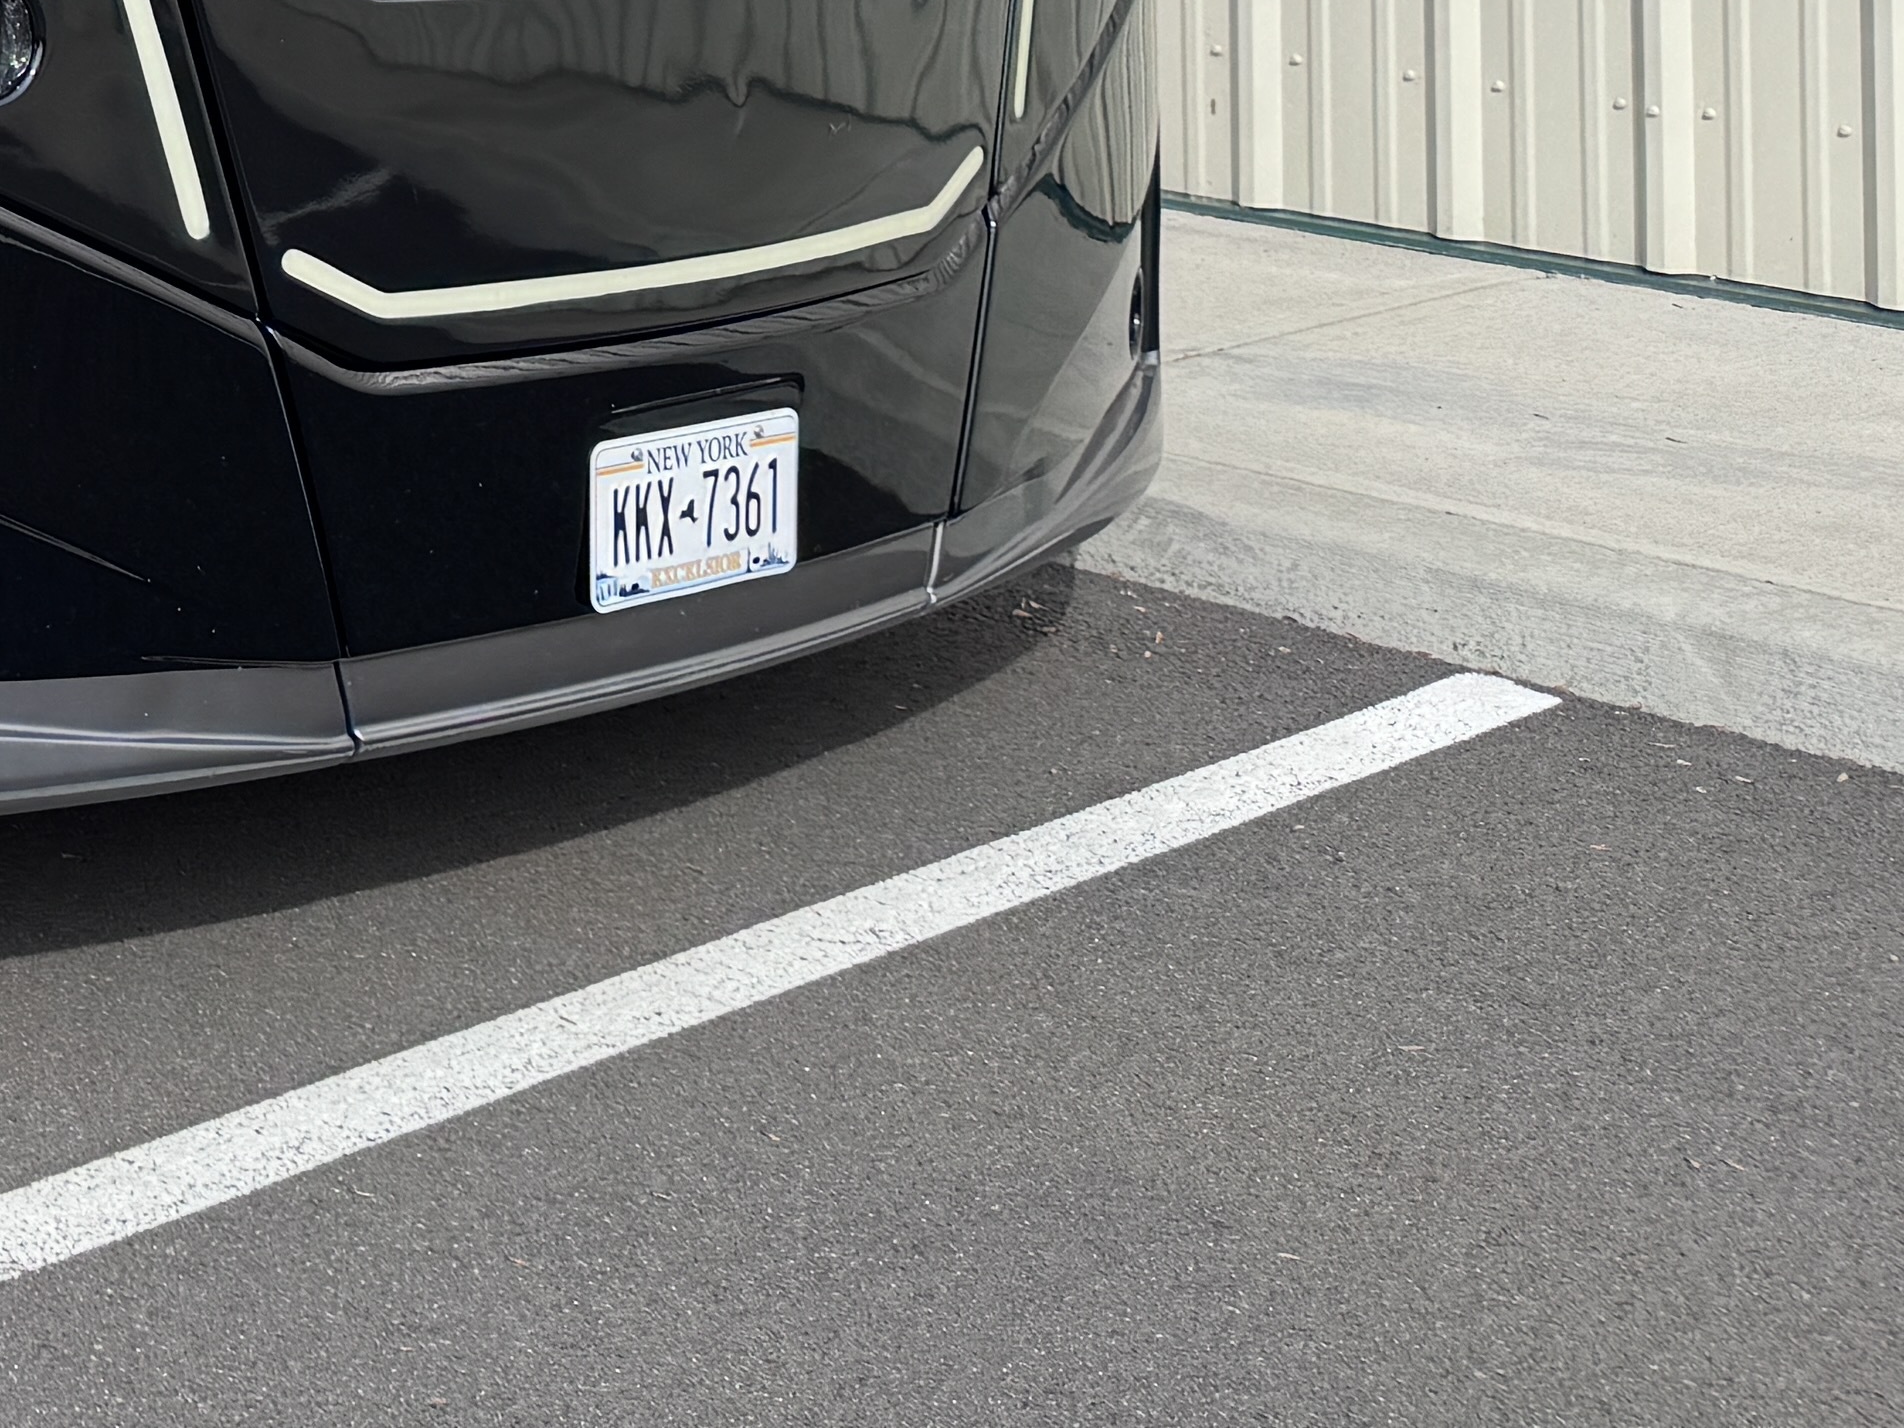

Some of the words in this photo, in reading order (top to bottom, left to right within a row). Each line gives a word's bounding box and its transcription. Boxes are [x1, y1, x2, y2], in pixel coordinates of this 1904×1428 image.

[647, 442, 692, 474] NEW
[696, 431, 748, 464] YORK
[650, 551, 742, 589] EXCELSIOR
